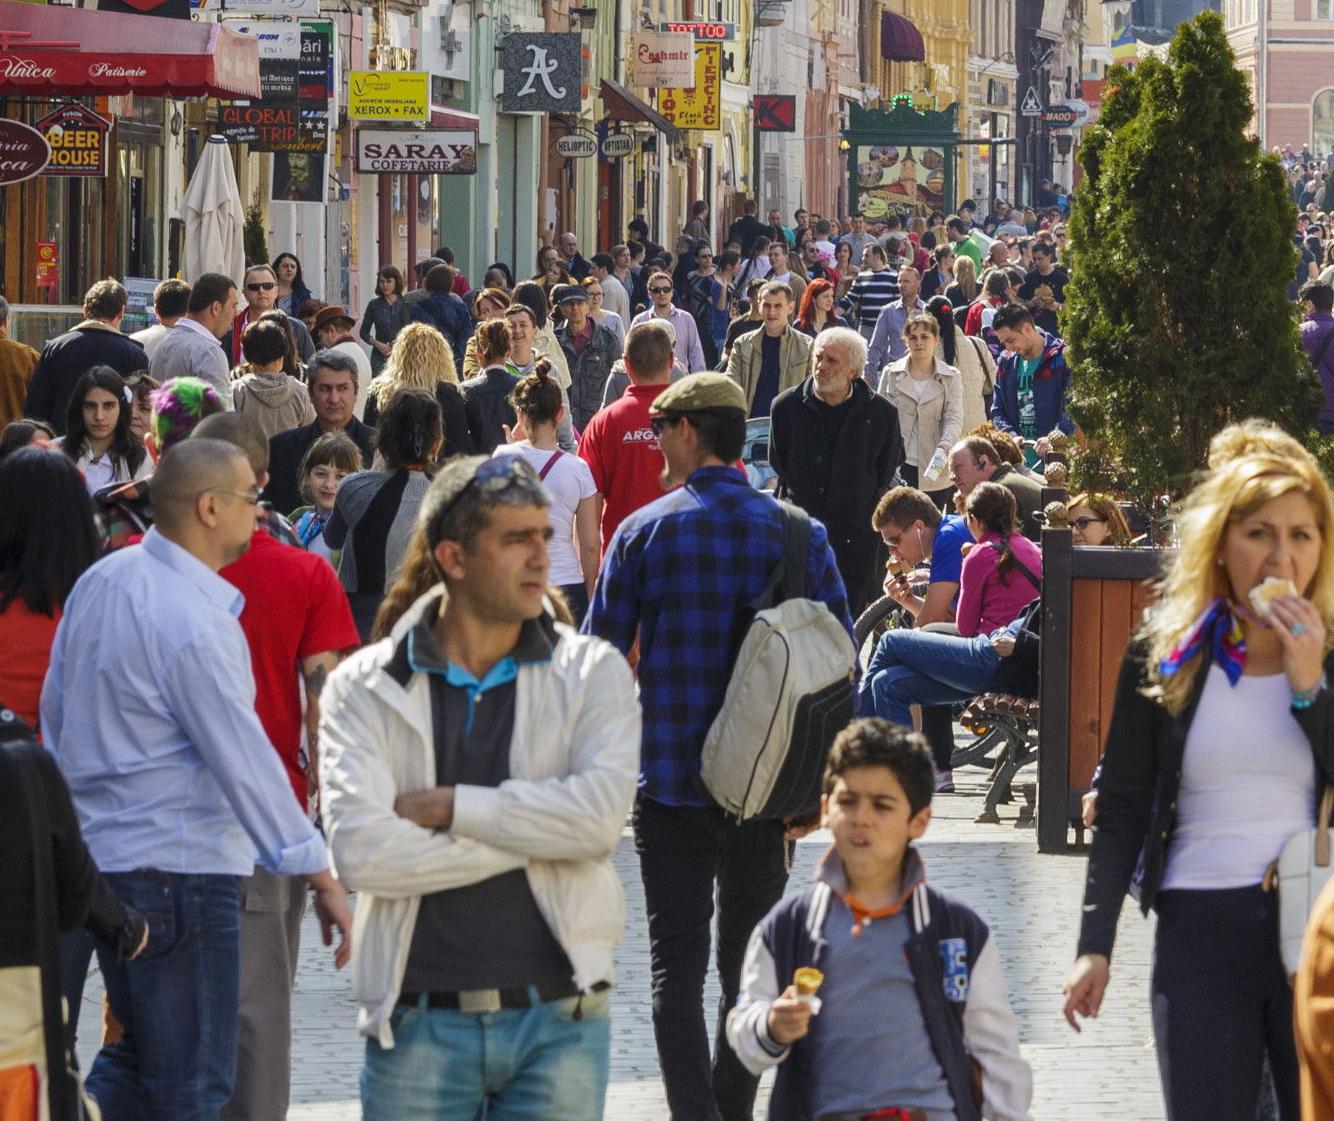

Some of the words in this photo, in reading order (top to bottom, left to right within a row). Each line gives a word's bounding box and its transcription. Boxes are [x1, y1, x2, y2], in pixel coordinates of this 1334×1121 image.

[637, 43, 689, 65] Cashmir
[88, 62, 148, 78] Patiserie
[516, 44, 567, 100] A
[222, 108, 297, 125] GLOBAL
[354, 106, 392, 115] XEROX
[403, 106, 424, 115] FAX
[1045, 111, 1072, 122] MADO
[50, 129, 100, 149] BEER
[258, 126, 297, 143] TRIP
[364, 143, 469, 160] SARAY
[557, 140, 594, 152] HELIOPTIC
[370, 160, 452, 172] COFETARIE
[622, 429, 659, 442] ARG
